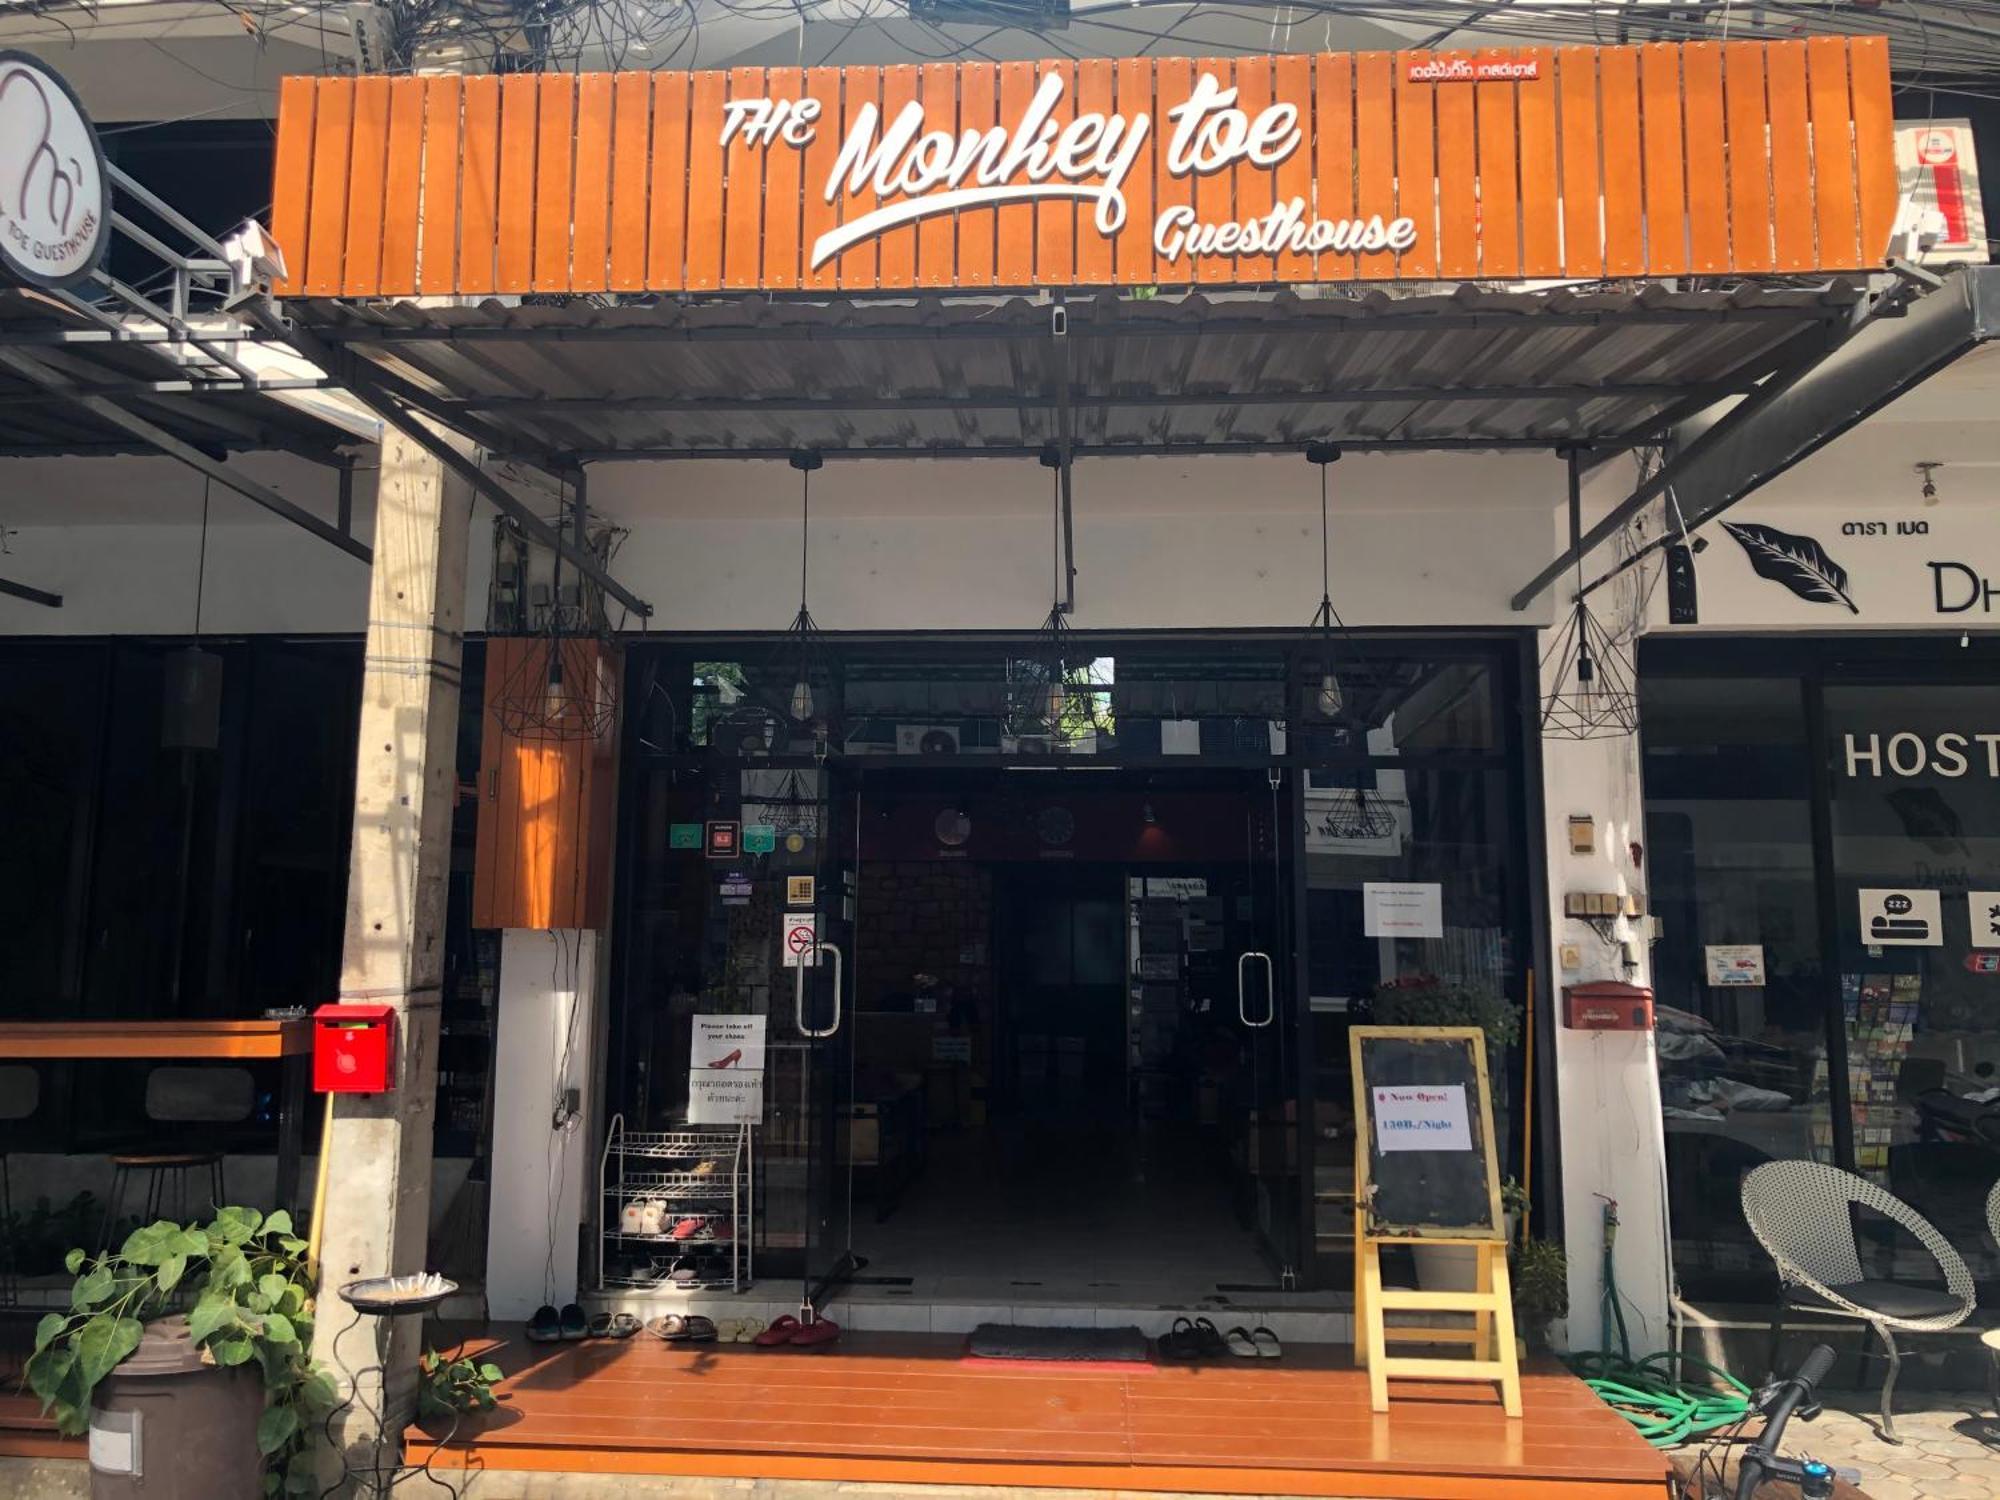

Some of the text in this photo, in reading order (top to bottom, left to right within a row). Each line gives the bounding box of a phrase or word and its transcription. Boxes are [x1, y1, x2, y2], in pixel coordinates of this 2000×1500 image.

[719, 70, 1301, 270] THE Monkey toe
[9, 208, 97, 261] TOE GUESTHOUSE
[1153, 196, 1418, 264] Guesthouse
[1841, 521, 1887, 536] ดารา
